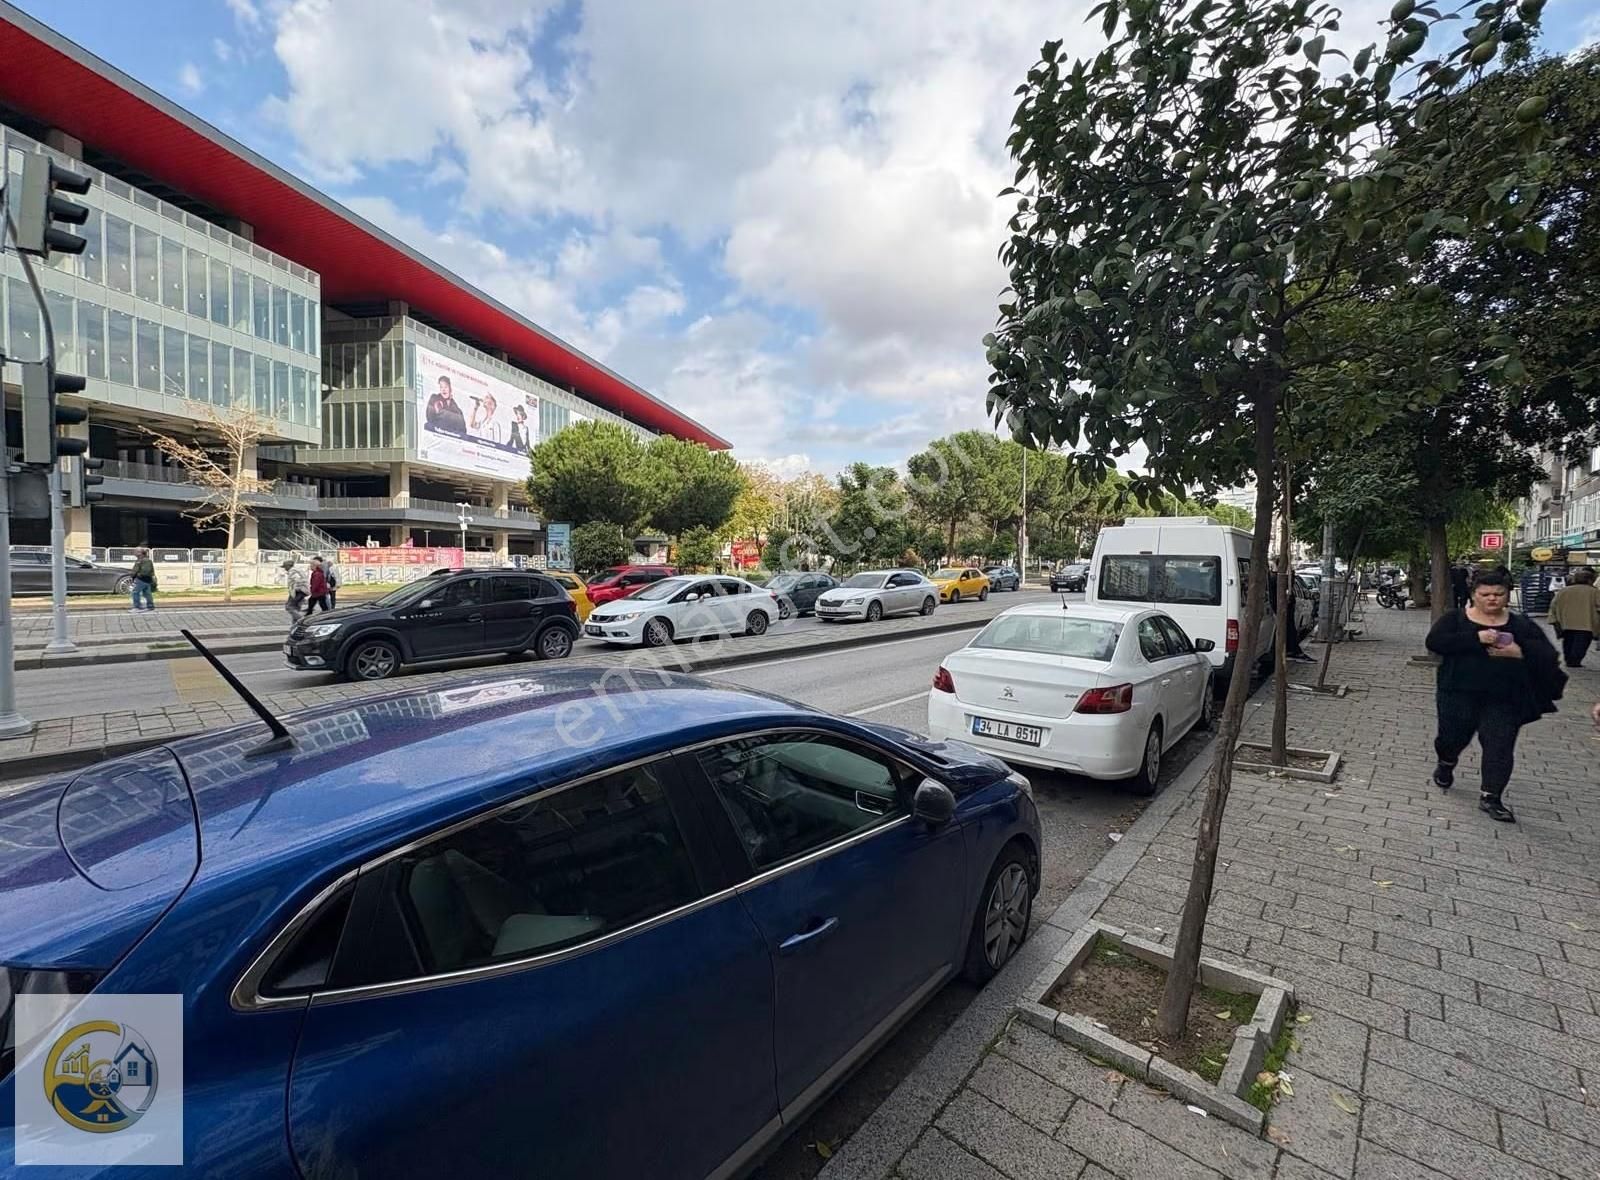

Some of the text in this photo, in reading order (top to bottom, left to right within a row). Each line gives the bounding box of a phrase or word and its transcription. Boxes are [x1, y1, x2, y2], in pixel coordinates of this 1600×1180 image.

[1488, 537, 1497, 546] E
[981, 720, 1038, 742] 34 LA 8511
